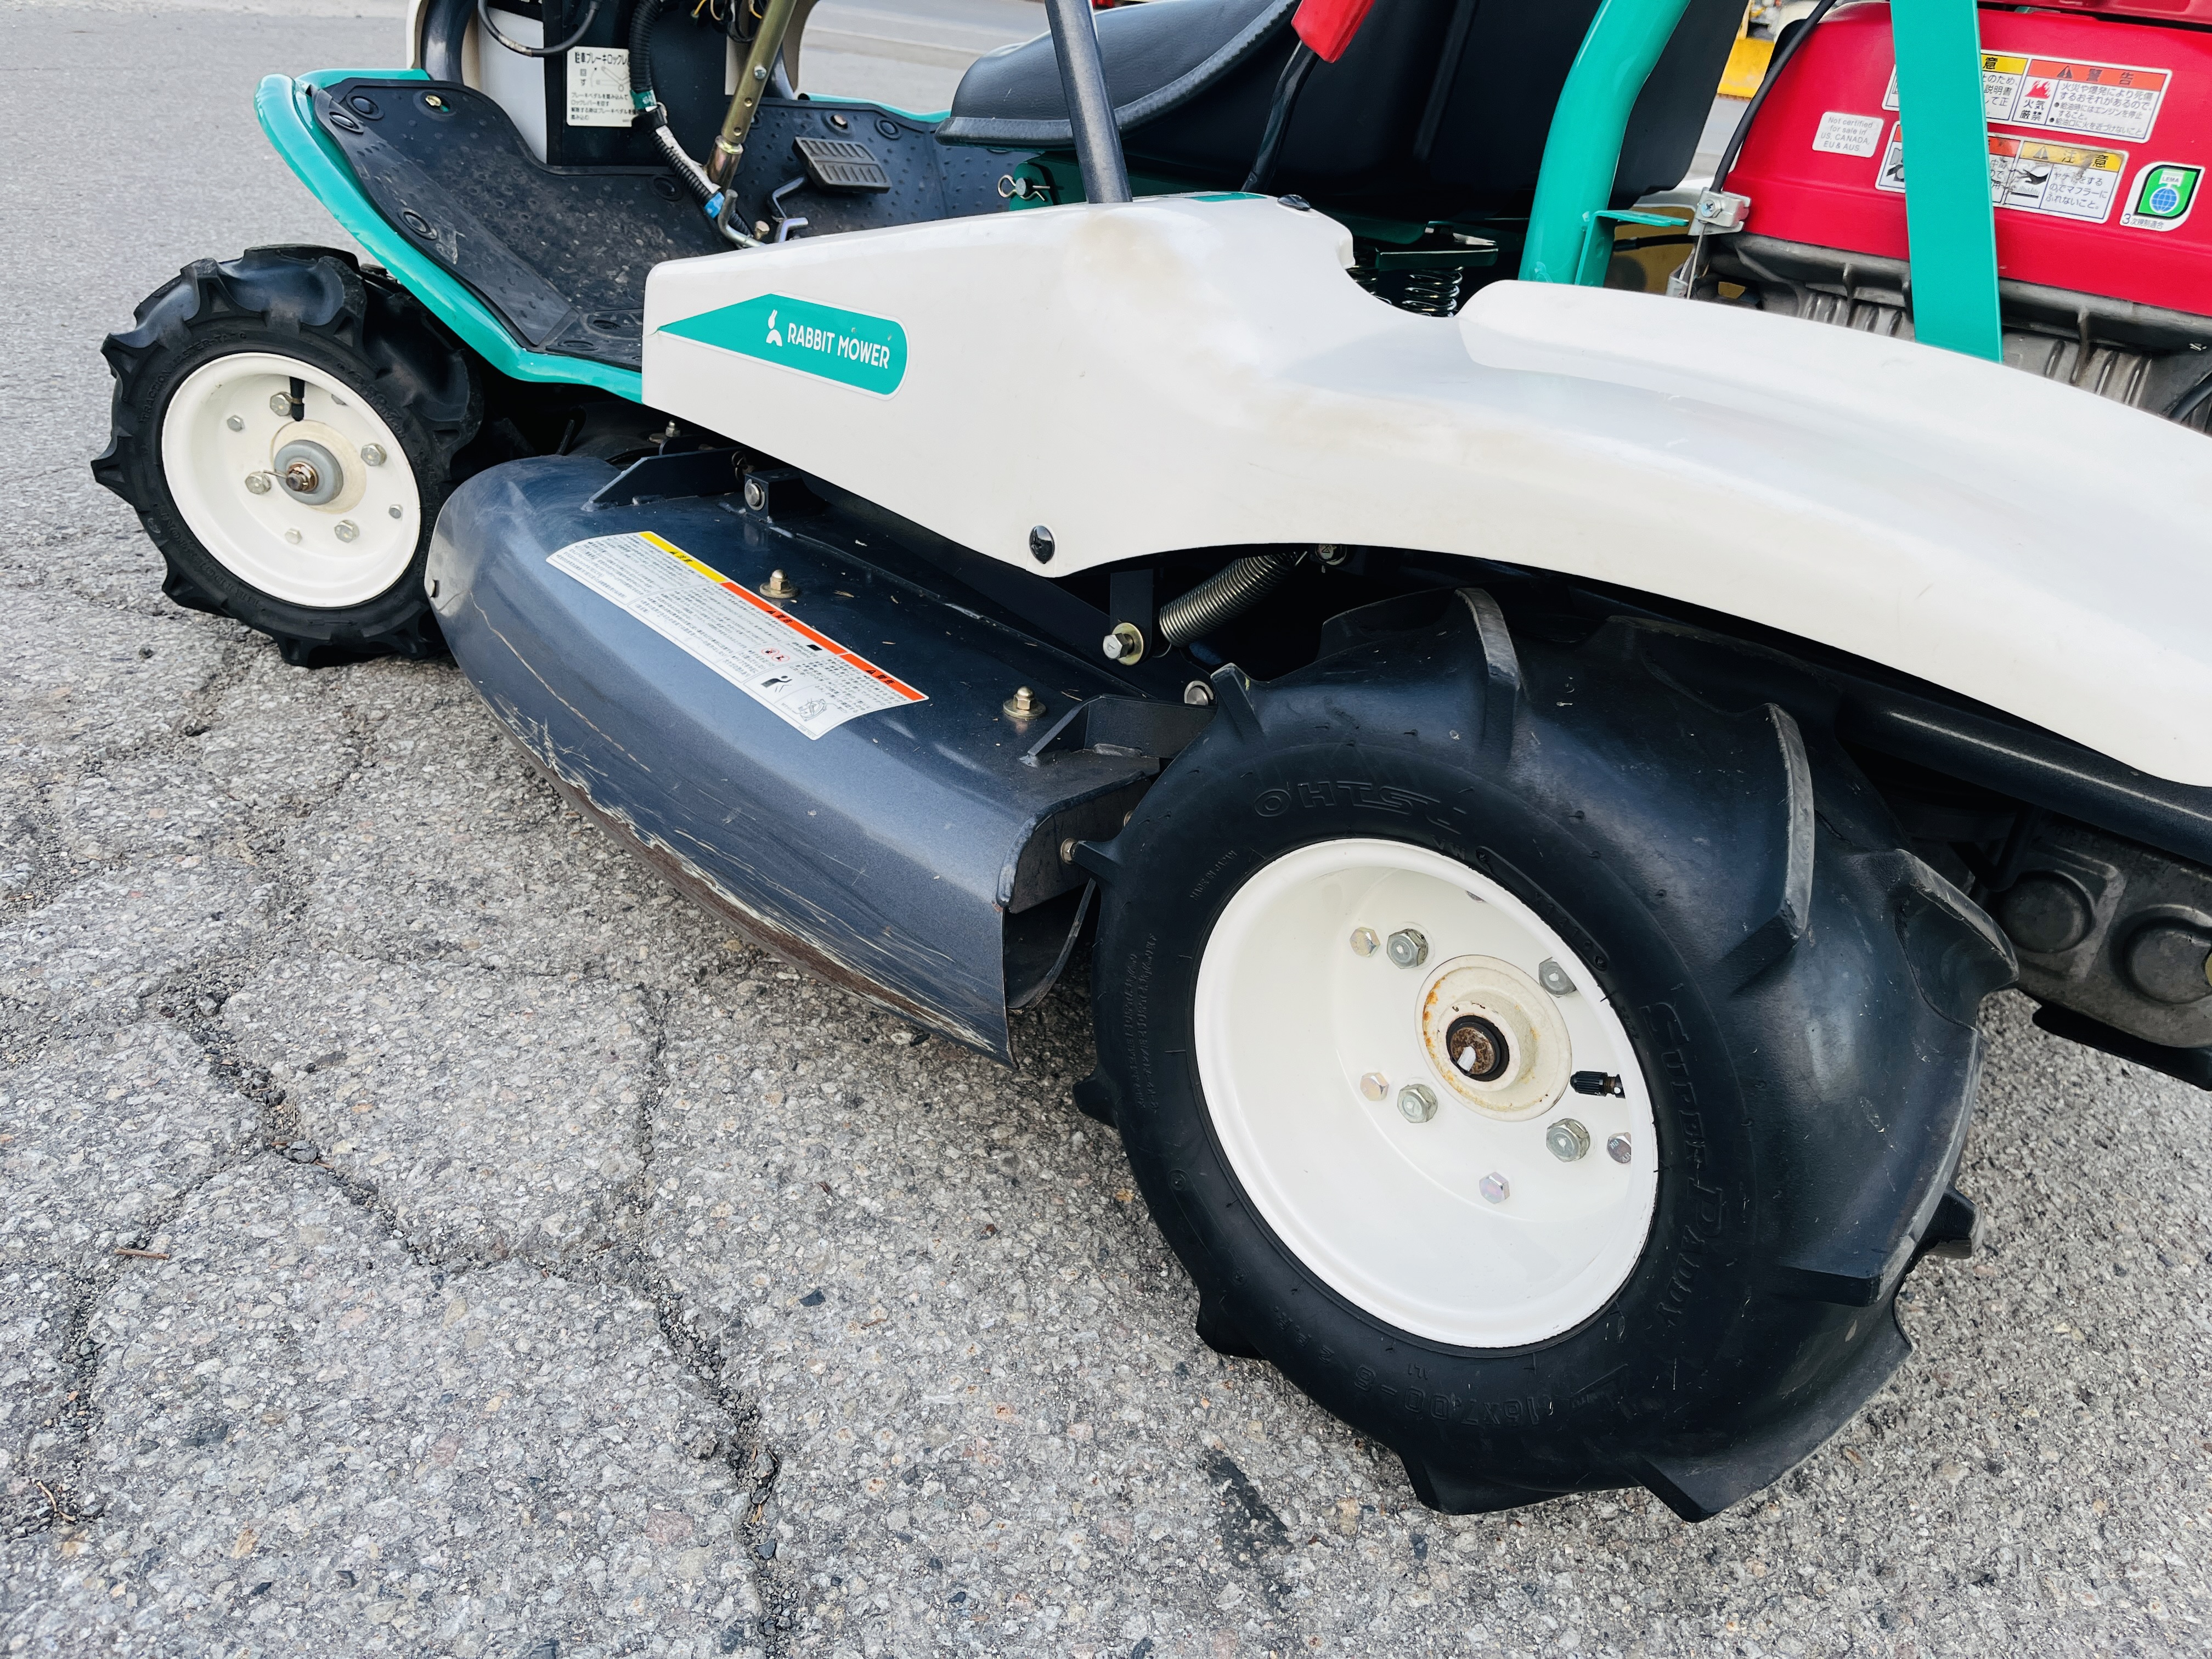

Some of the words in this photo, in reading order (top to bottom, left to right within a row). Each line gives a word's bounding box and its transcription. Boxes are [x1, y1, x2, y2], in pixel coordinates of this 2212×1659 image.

[1983, 57, 1998, 70] 意
[2023, 99, 2045, 110] 火気
[2019, 110, 2042, 121] 厳禁
[1843, 120, 1873, 128] certified
[1835, 134, 1870, 145] CANADA,
[2050, 183, 2108, 199] のでマフラーに
[2046, 194, 2099, 210] ふれないこと。
[788, 323, 835, 354] RABBIT
[838, 337, 890, 369] MOWER
[1188, 874, 1210, 902] MADE
[1212, 847, 1238, 873] JAPAN
